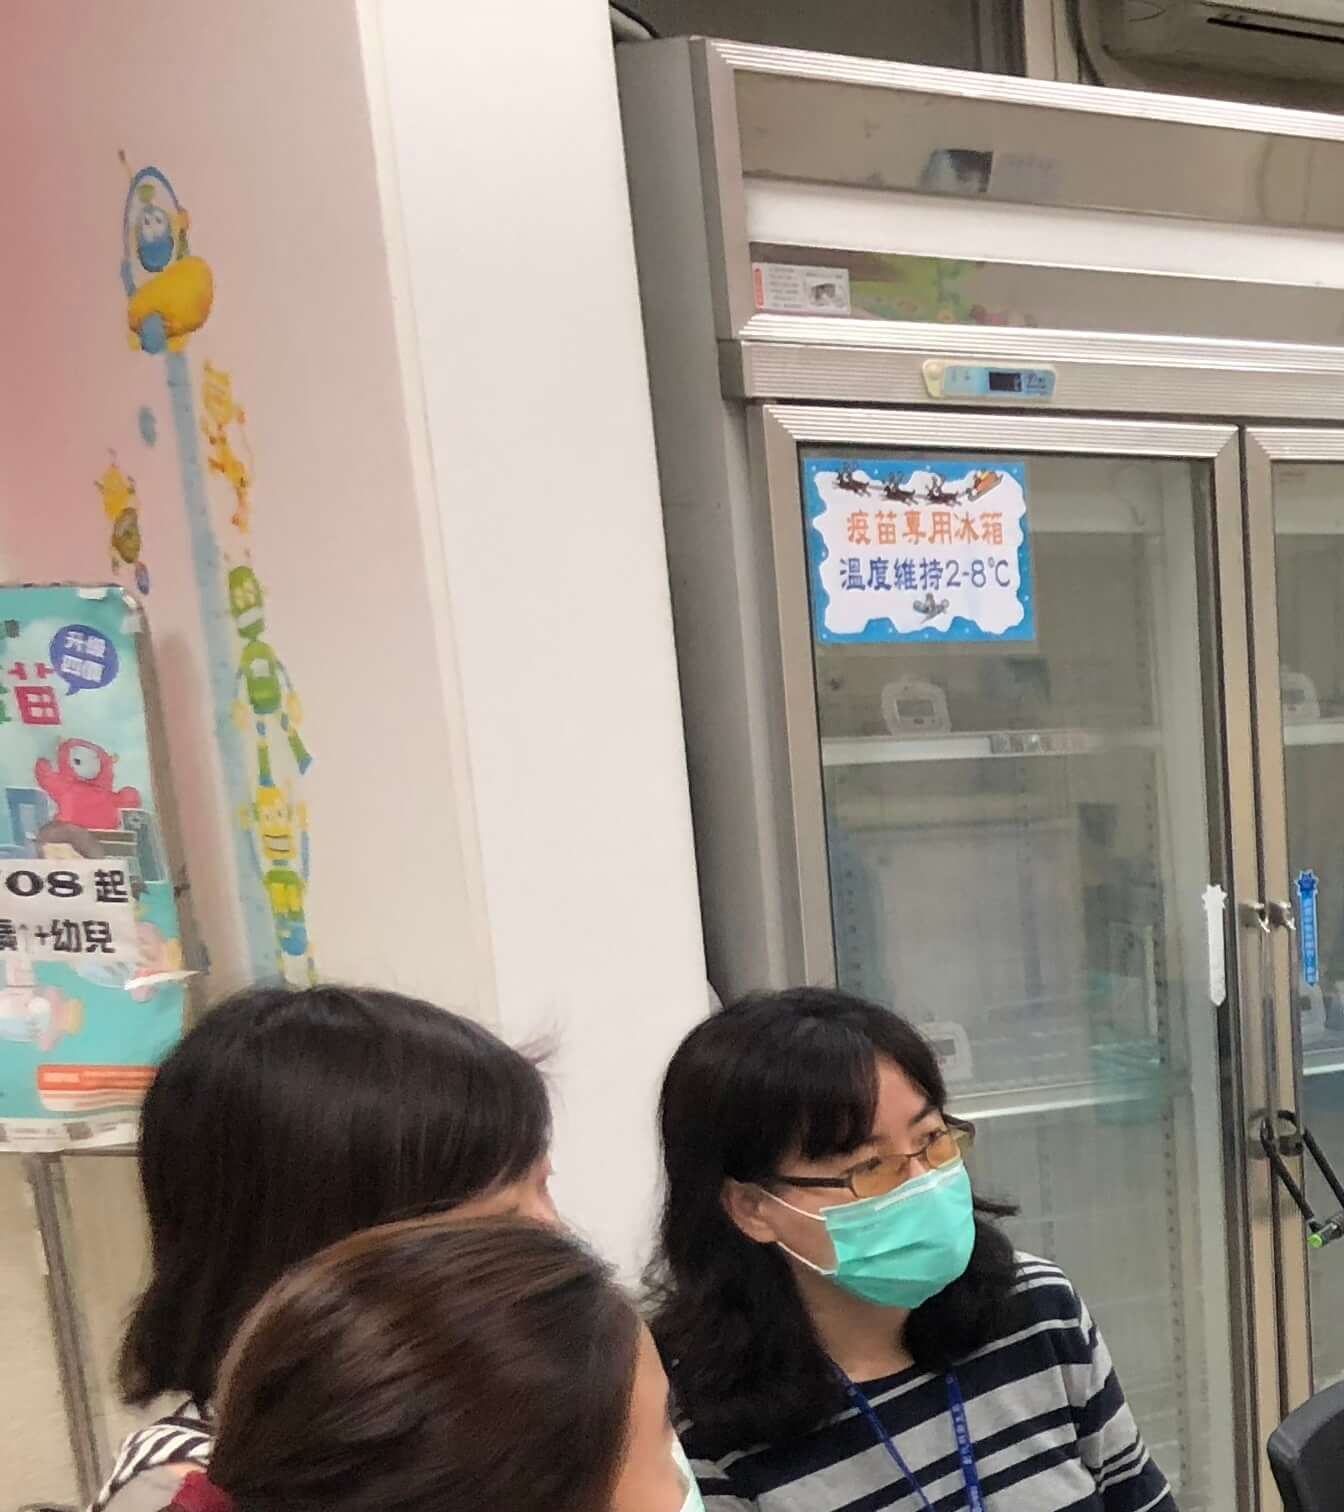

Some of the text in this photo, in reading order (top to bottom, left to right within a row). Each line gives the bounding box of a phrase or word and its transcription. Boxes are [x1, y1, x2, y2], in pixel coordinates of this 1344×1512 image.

[847, 510, 1004, 545] 疫苗專用冰箱
[94, 868, 129, 903] 起
